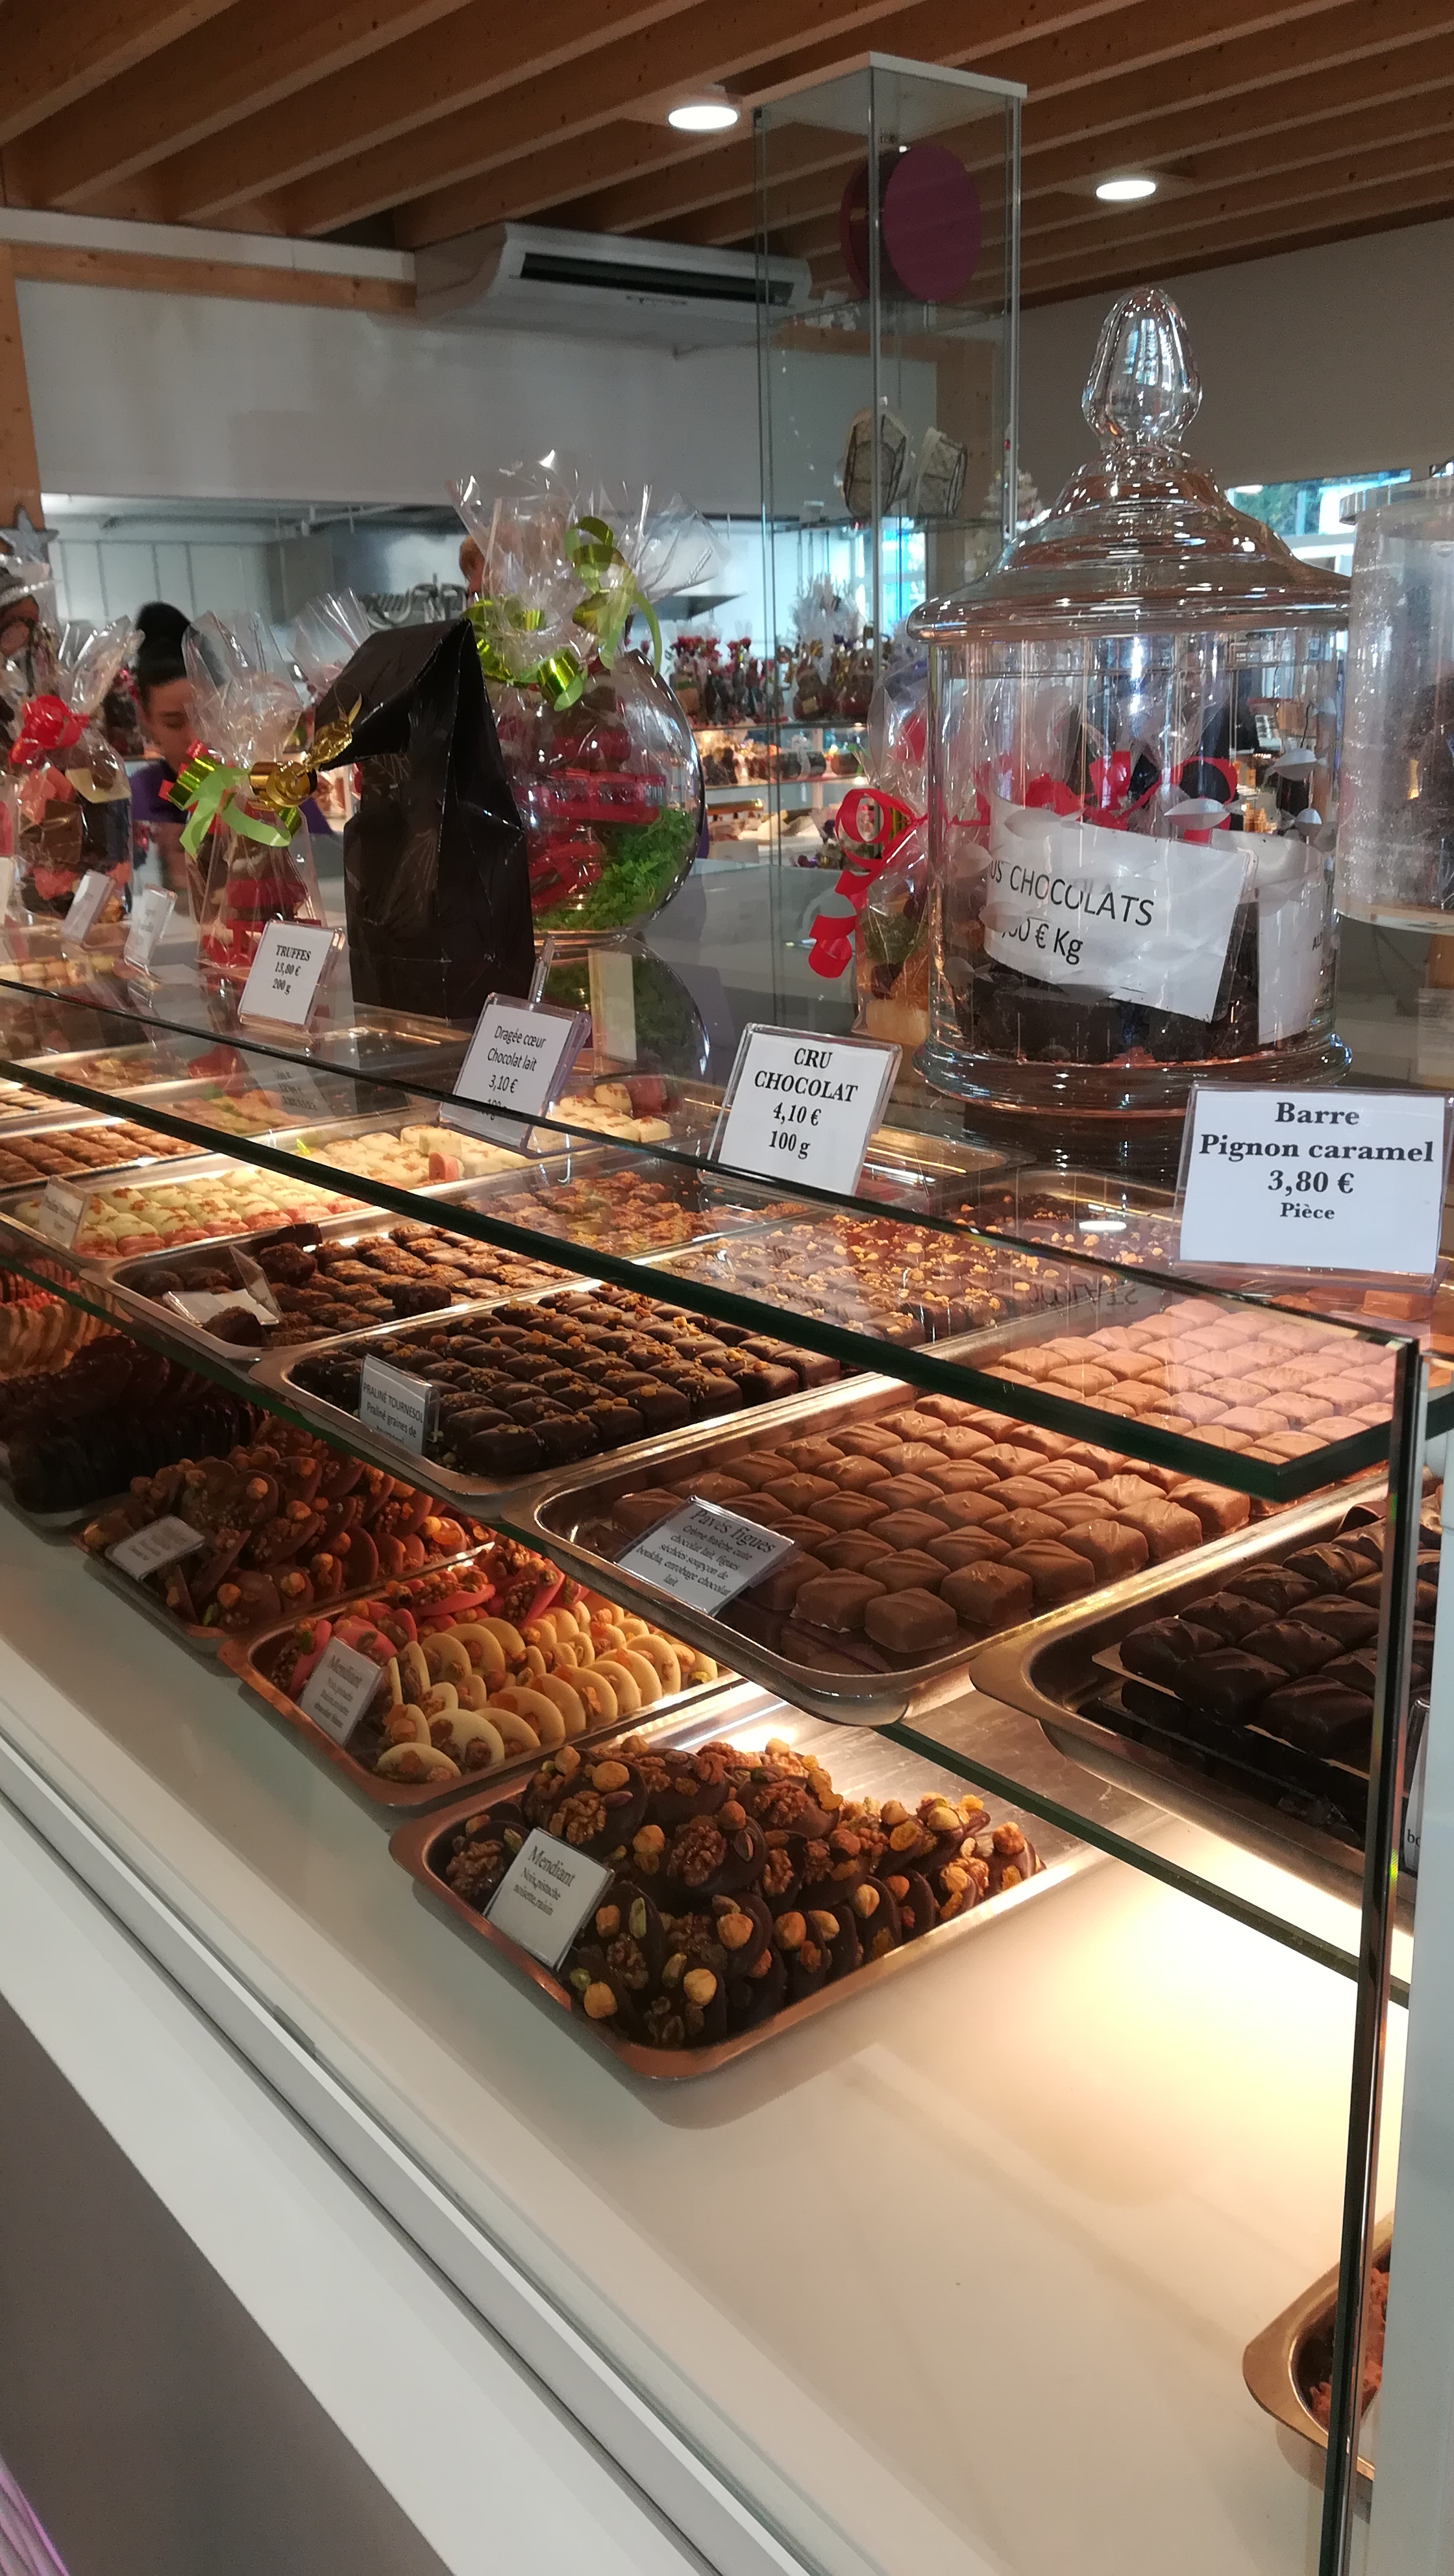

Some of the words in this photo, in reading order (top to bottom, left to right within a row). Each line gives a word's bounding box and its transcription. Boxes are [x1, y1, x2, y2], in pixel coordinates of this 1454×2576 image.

[1009, 865, 1155, 926] CHOCOLATS
[276, 945, 312, 961] TRUFFES
[1035, 924, 1049, 948] €
[1054, 928, 1083, 965] Kg
[275, 961, 295, 977] 13,80
[295, 966, 302, 976] €
[272, 978, 286, 990] 200
[285, 984, 291, 995] g
[495, 1025, 522, 1045] Dragée
[523, 1034, 547, 1048] cœur
[487, 1048, 523, 1069] Chocolat
[523, 1055, 537, 1072] lait
[794, 1047, 833, 1069] CRU
[489, 1074, 510, 1091] 3,10
[510, 1079, 518, 1093] €
[754, 1071, 858, 1102] CHOCOLAT
[773, 1102, 807, 1124] 4,10
[811, 1108, 822, 1126] €
[1275, 1102, 1360, 1125] Barre
[769, 1131, 796, 1152] 100
[798, 1142, 811, 1159] g
[1199, 1134, 1300, 1161] Pignon
[1309, 1141, 1433, 1162] caramel
[1268, 1170, 1329, 1196] 3,80
[1338, 1172, 1354, 1194] €
[1280, 1202, 1335, 1219] Pièce
[363, 1382, 387, 1404] PRALINÉ
[388, 1395, 424, 1424] TOURNESOL
[367, 1402, 386, 1421] Praliné
[387, 1414, 408, 1434] graines
[408, 1425, 417, 1438] de
[690, 1509, 732, 1534] Pavés
[731, 1526, 776, 1554] figues
[717, 1567, 729, 1581] de
[527, 1846, 576, 1888] Mendiant
